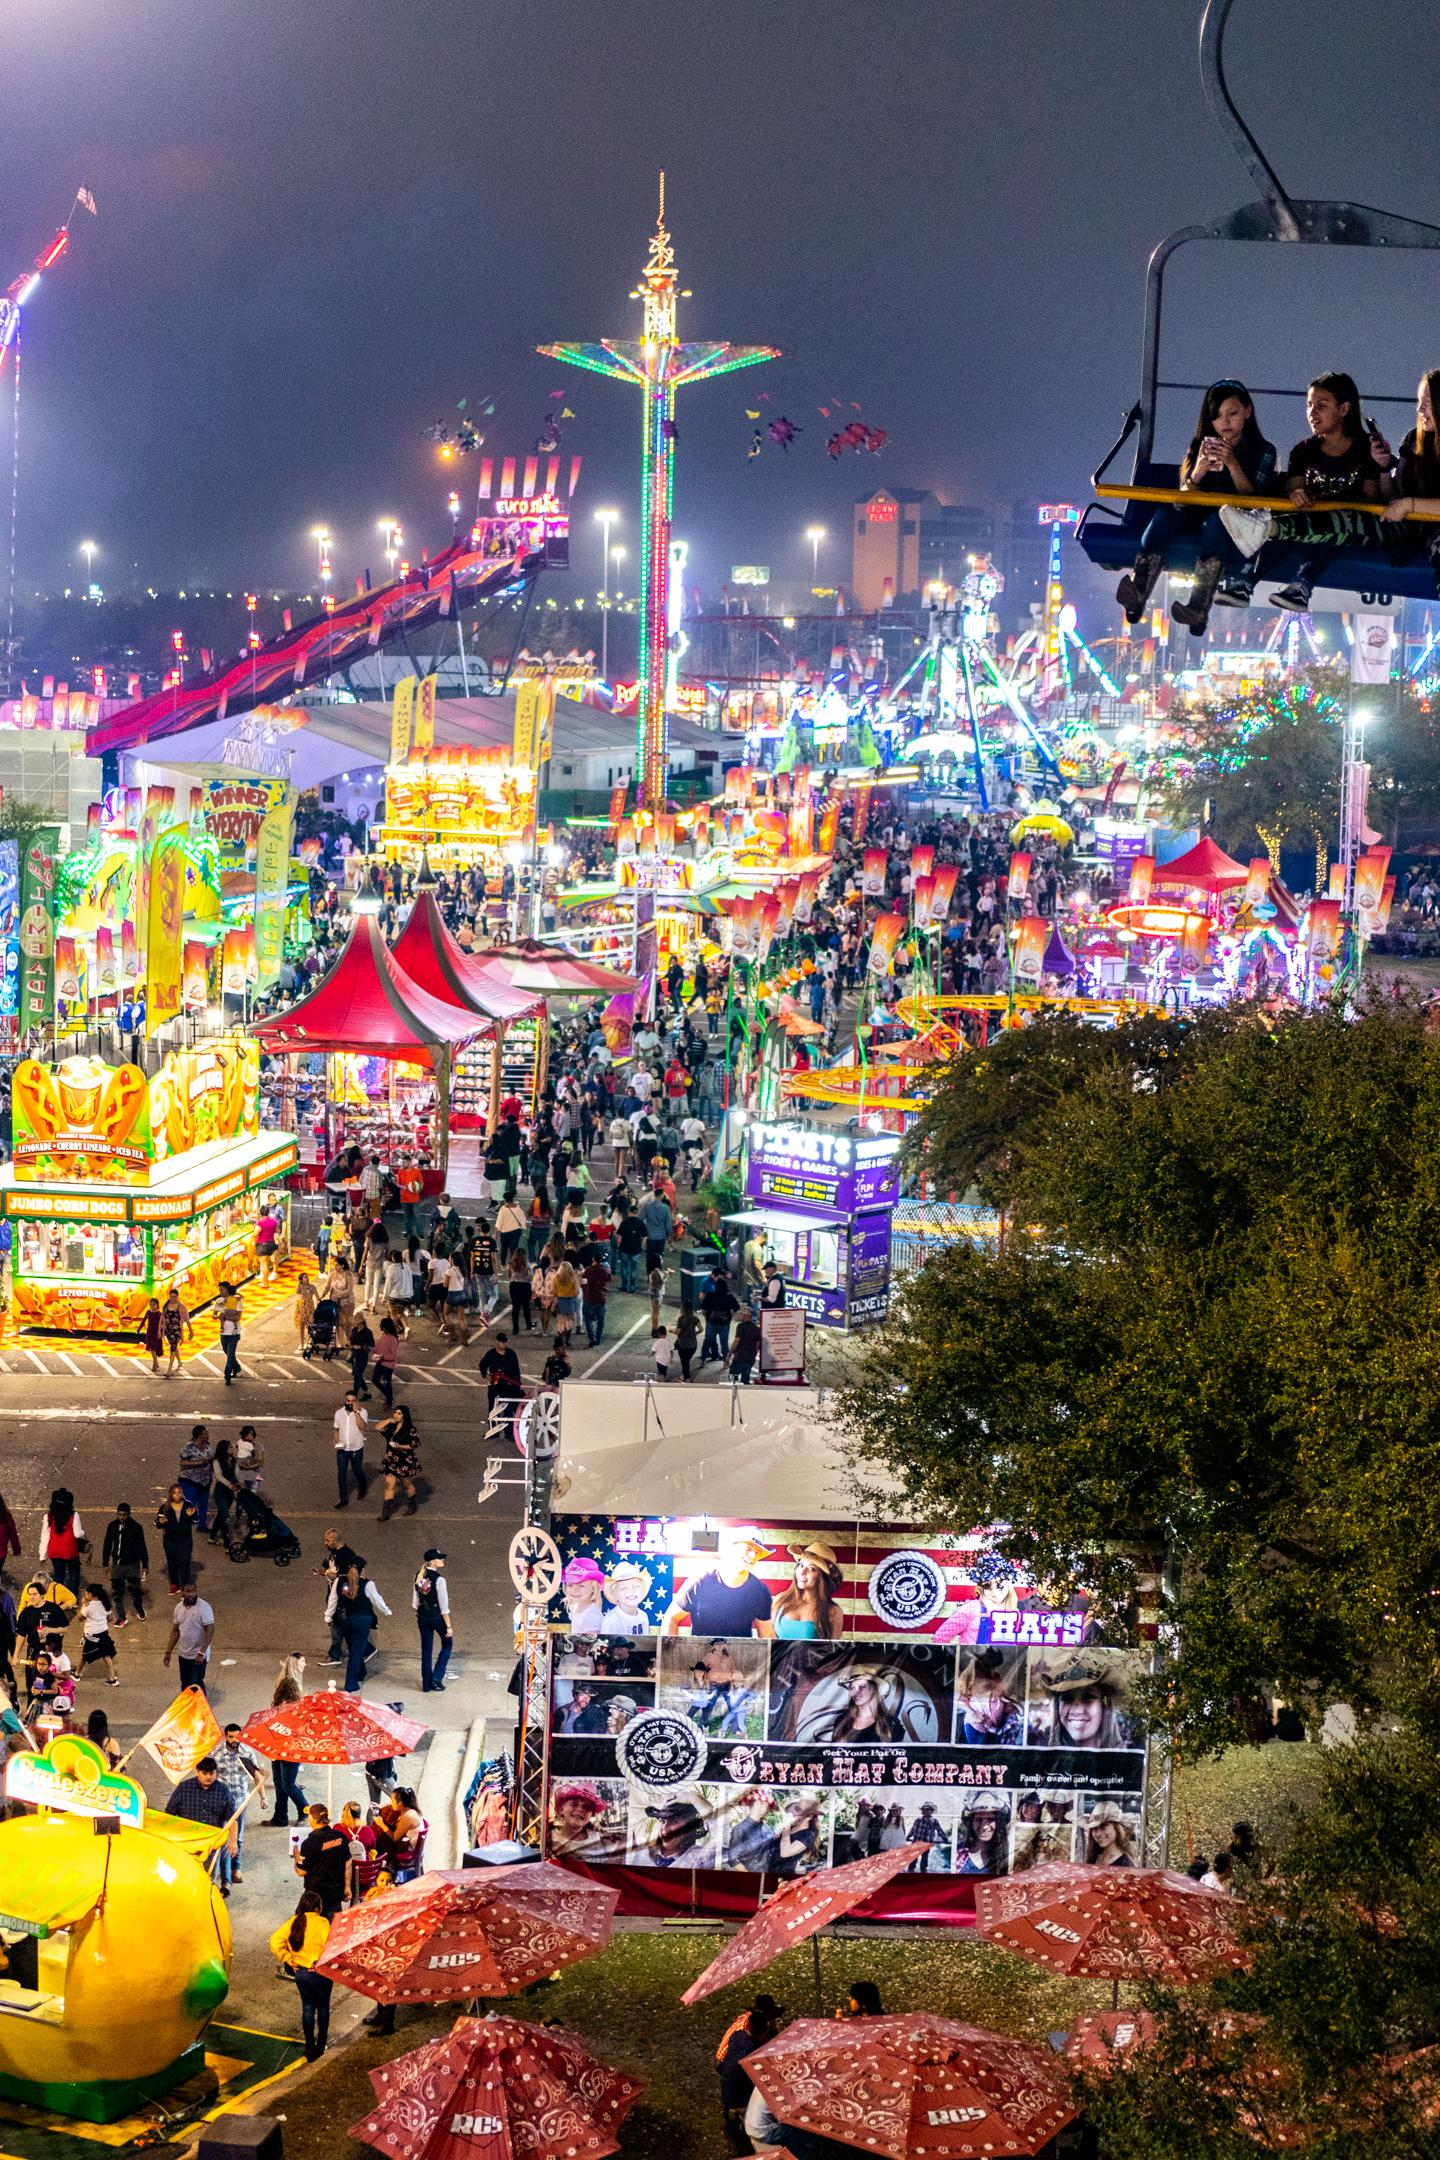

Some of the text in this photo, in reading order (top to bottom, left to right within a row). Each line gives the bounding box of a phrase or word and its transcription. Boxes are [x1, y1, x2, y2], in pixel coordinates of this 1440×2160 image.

[866, 504, 897, 513] CROWNE
[870, 513, 893, 521] PLAZA
[209, 786, 269, 809] WINNER
[205, 811, 244, 842] EVERY
[18, 1142, 144, 1160] LEMONADE CHERRY LIMEADE ICED TEA
[750, 1123, 851, 1165] TICKETS
[762, 1154, 792, 1169] RIDES
[792, 1160, 801, 1170] &
[801, 1161, 838, 1176] GAMES
[855, 1159, 872, 1171] RIDES
[860, 1183, 874, 1193] FUN
[9, 1196, 125, 1215] JUMBO CORN DOGS
[135, 1198, 192, 1216] LEMONADE
[58, 1288, 108, 1300] LEMONADE
[785, 1292, 826, 1313] CKETS
[850, 1294, 888, 1314] TICKETS
[896, 1603, 920, 1613] USA
[990, 1610, 1085, 1646] HATS
[629, 1719, 696, 1749] O'RYAN HAT COMPANY.COM
[822, 1748, 907, 1760] Get Your Hat On
[649, 1766, 676, 1777] USA
[1019, 1770, 1124, 1789] Family owned and operated
[19, 1758, 132, 1810] Squeezers
[1034, 1918, 1082, 1945] RCS
[428, 1952, 481, 1970] RCS
[450, 2113, 503, 2135] RCS
[927, 2106, 987, 2128] RCS
